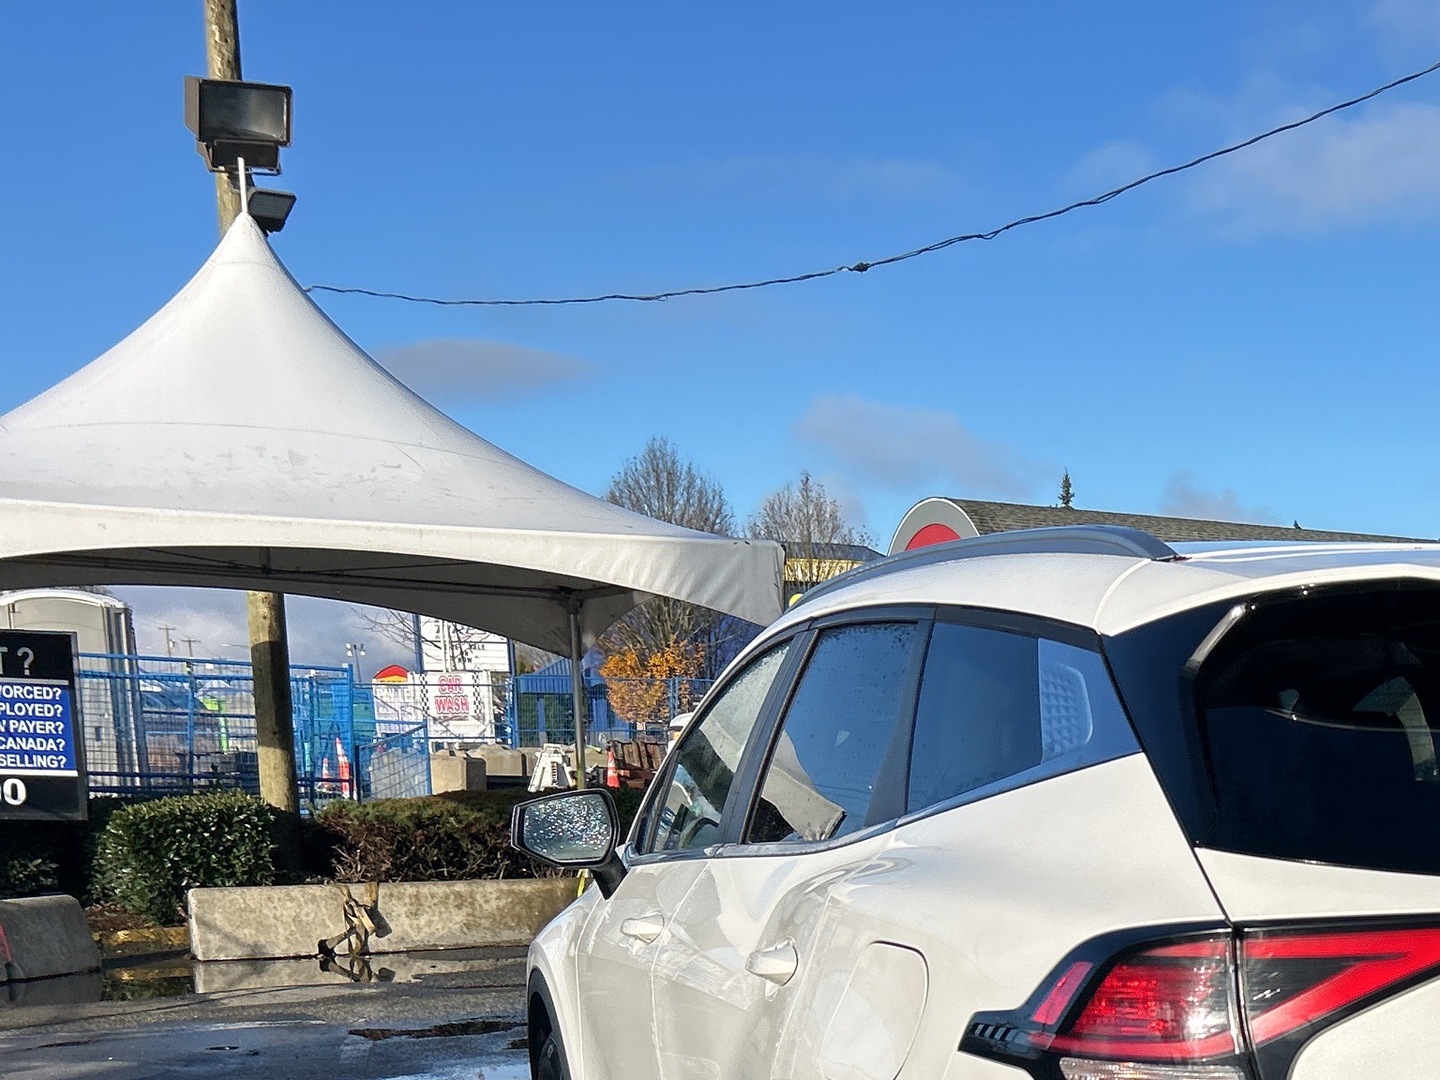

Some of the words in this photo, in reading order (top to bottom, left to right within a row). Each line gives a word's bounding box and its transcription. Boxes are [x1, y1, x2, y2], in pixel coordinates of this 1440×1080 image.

[438, 675, 463, 694] CAR
[434, 694, 469, 715] WASH
[10, 720, 65, 734] PAYER?
[0, 737, 66, 751] CANADA?
[0, 754, 67, 768] SELLING?
